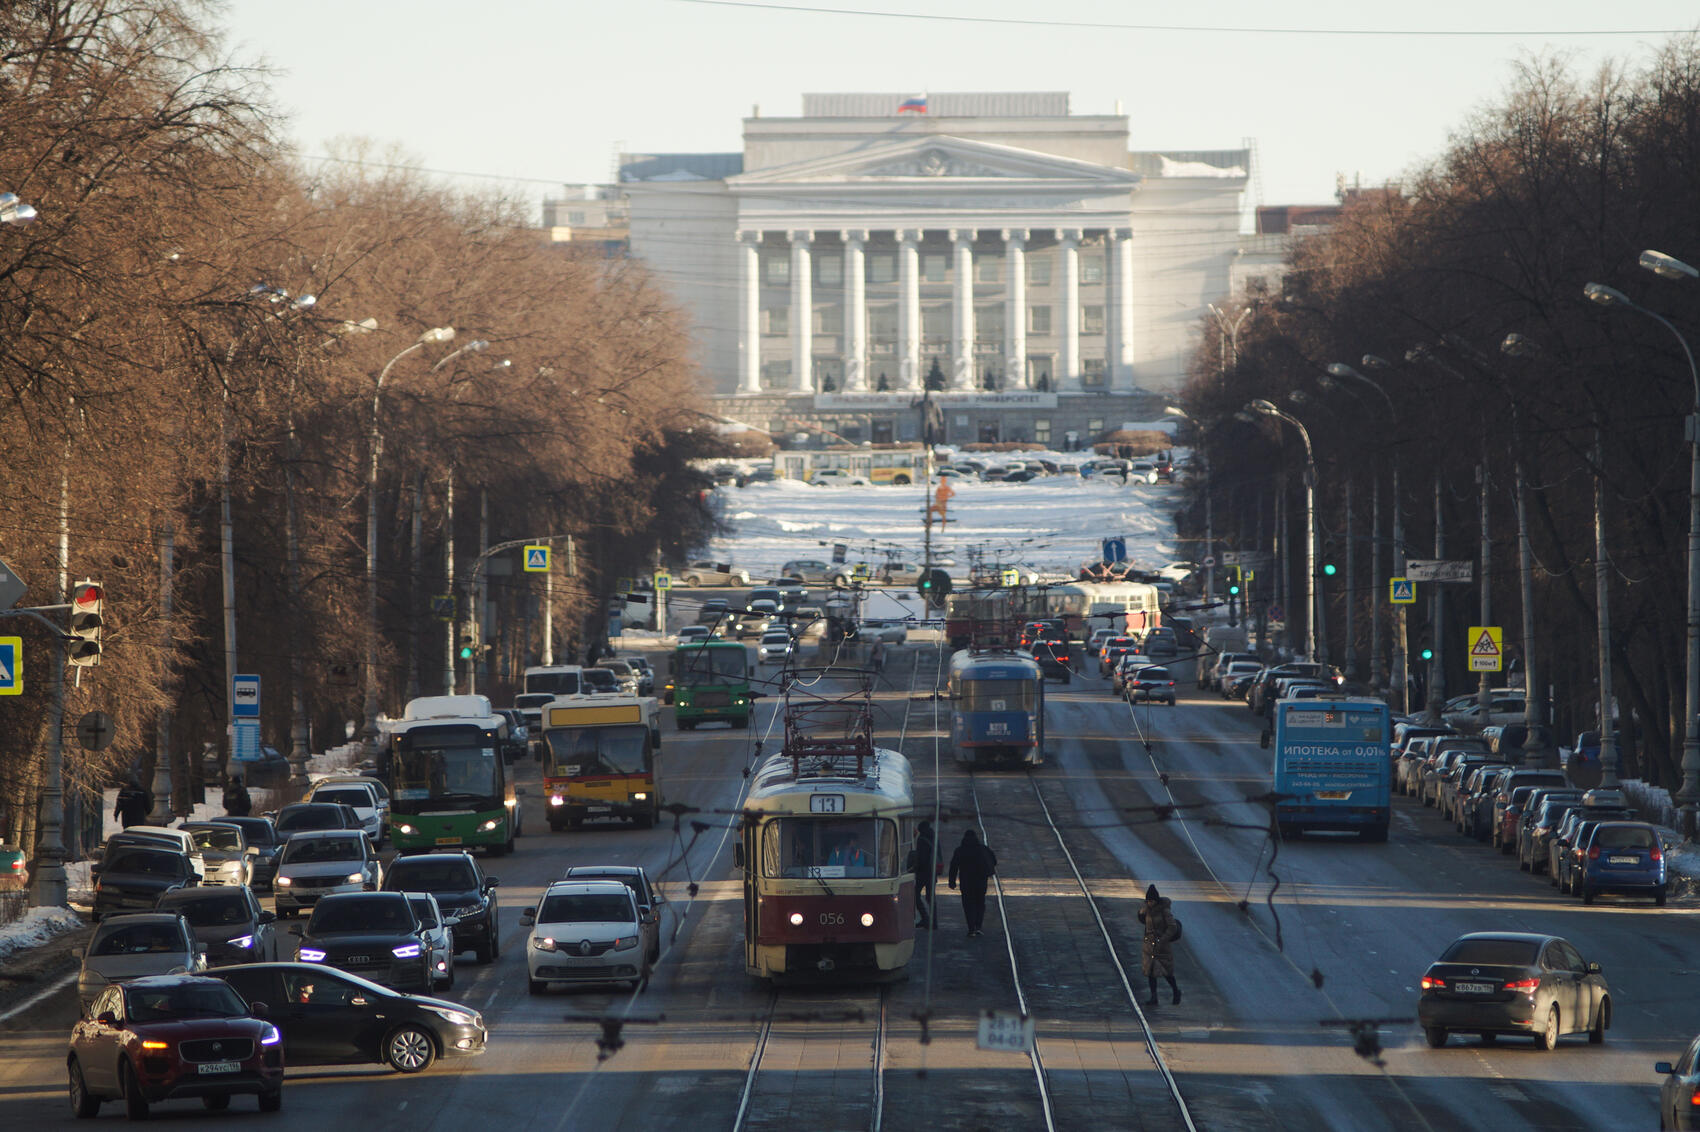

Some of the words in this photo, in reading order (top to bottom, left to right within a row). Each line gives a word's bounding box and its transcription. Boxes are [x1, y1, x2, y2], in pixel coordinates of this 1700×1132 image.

[1284, 746, 1339, 755] ИПОТЕКА
[818, 798, 835, 812] 13
[819, 912, 845, 925] 056
